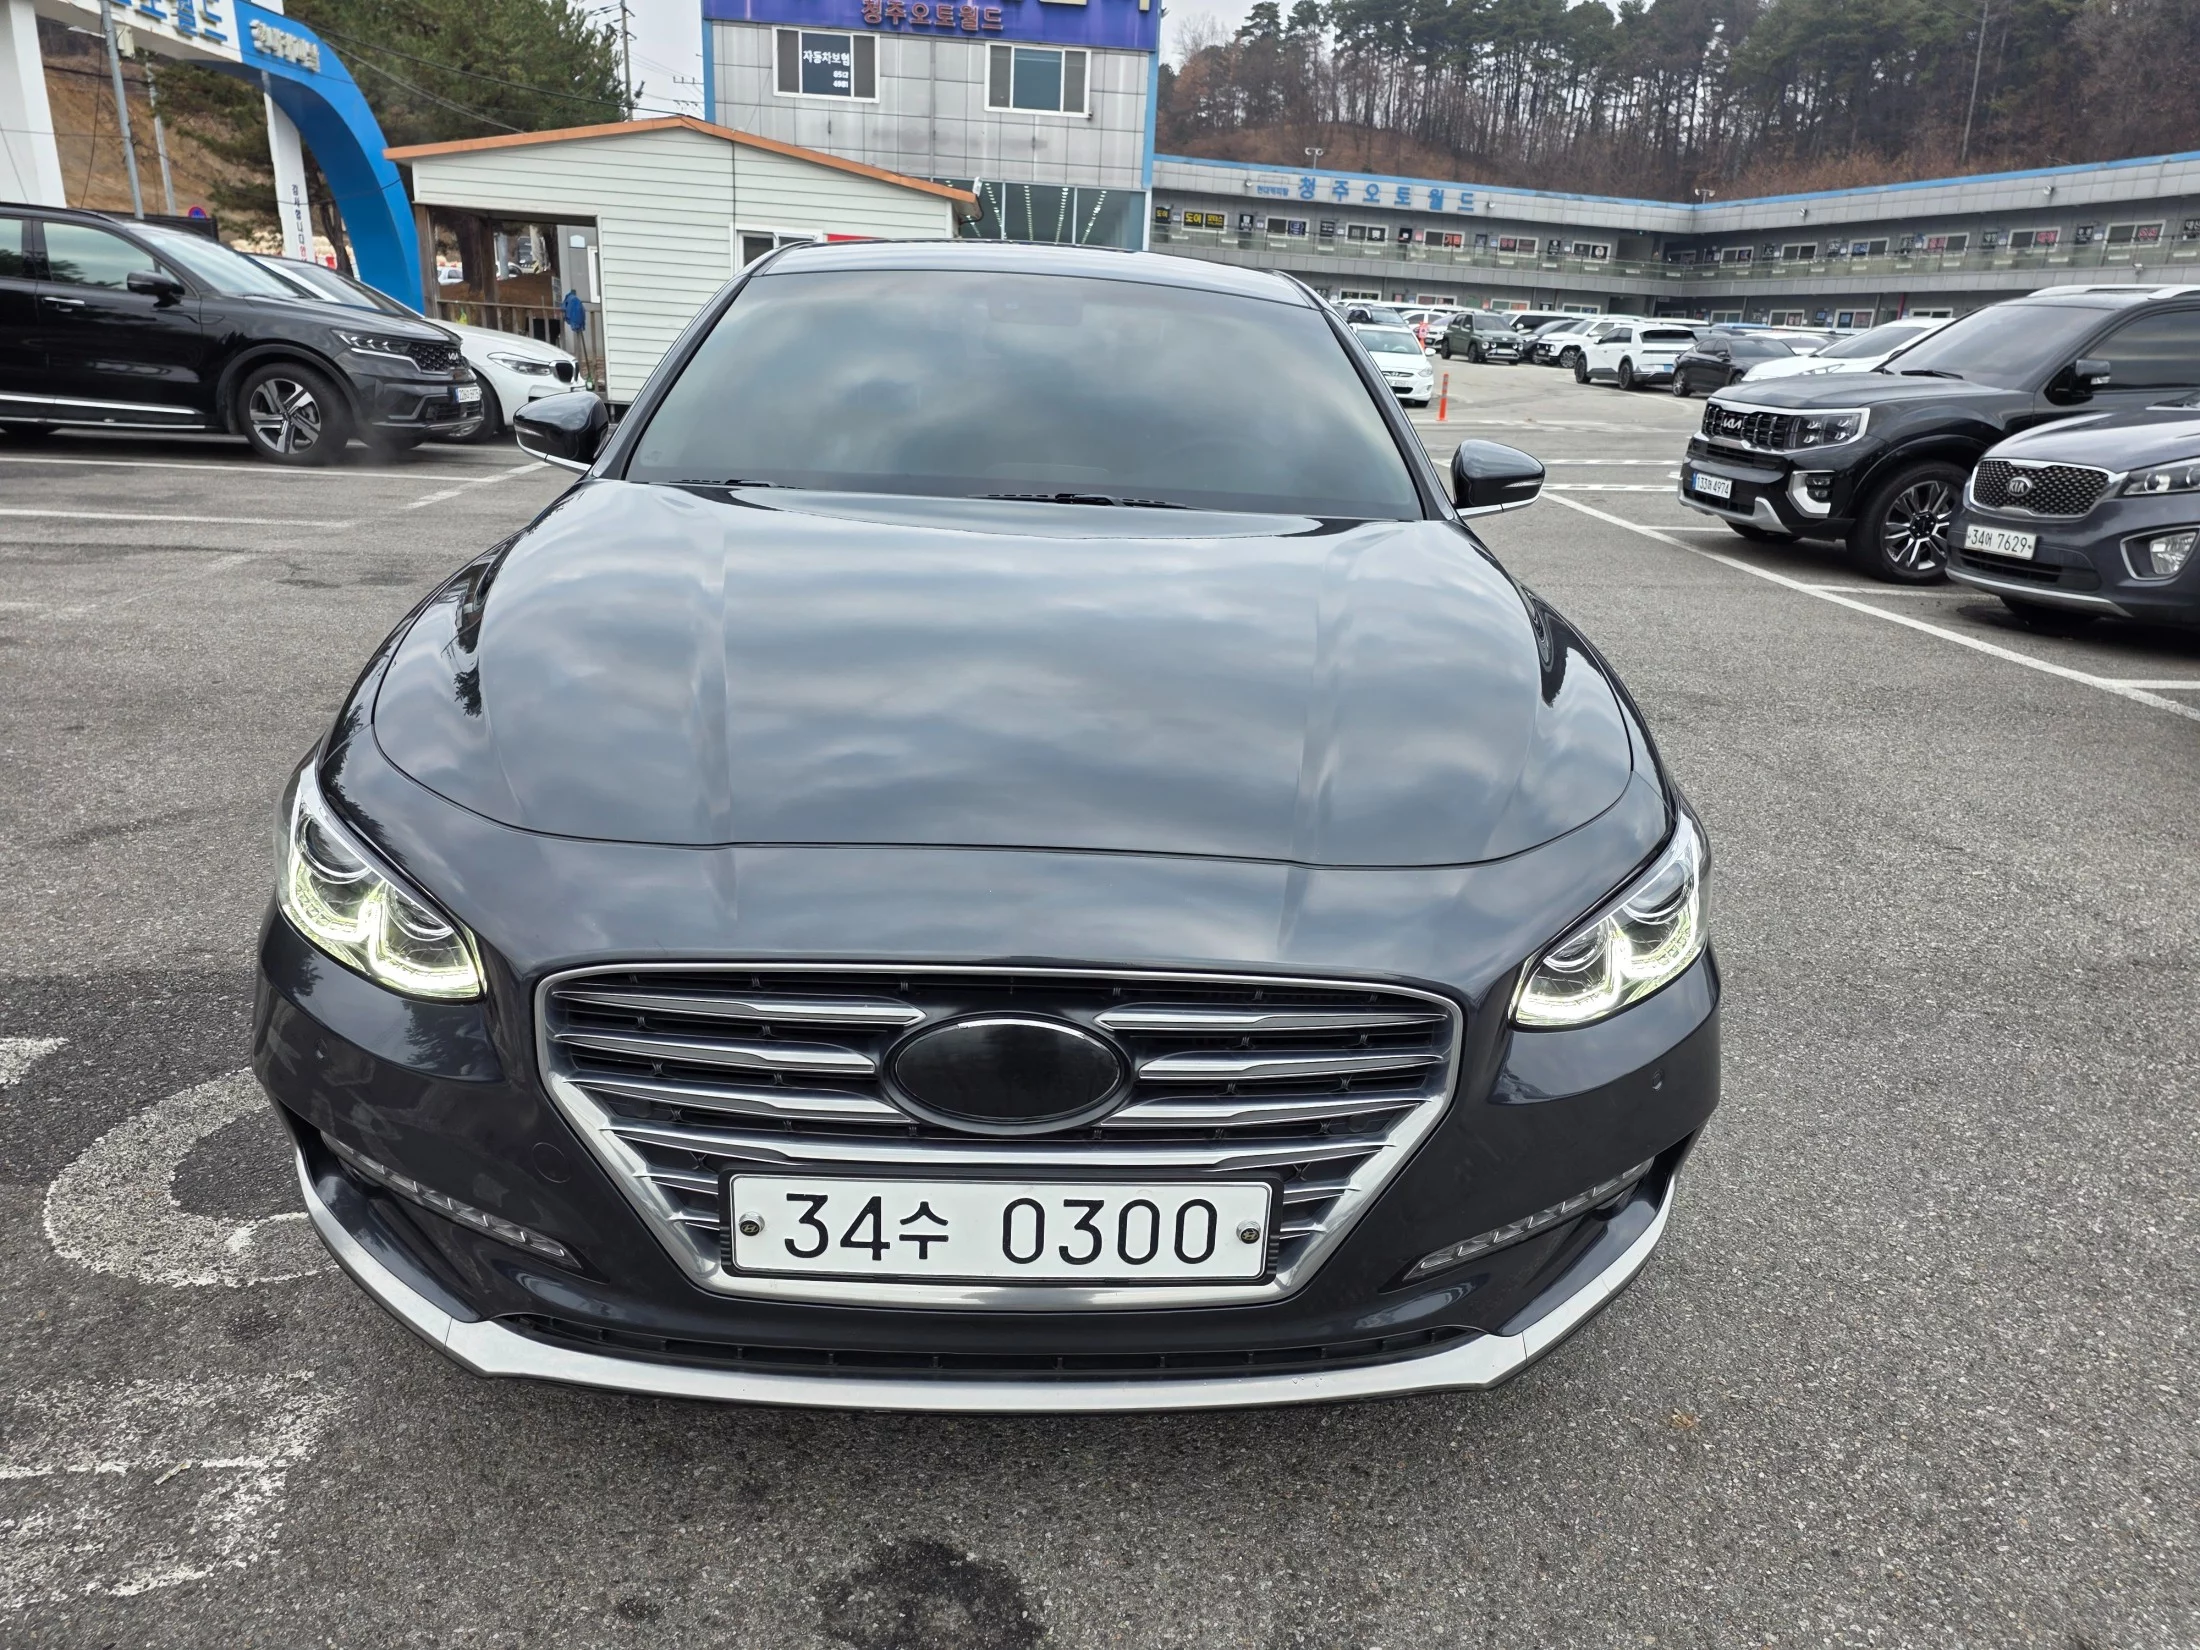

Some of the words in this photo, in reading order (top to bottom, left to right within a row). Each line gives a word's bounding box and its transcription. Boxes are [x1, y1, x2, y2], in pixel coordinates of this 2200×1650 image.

[111, 0, 229, 42] 월드
[861, 0, 1003, 31] 청주오토월드
[803, 49, 850, 67] 자동차보험
[1299, 176, 1475, 212] 청주오토월드
[291, 184, 305, 245] 감사합니다
[1723, 418, 1742, 430] KIA
[1712, 480, 1729, 494] 4974
[2008, 481, 2025, 493] KIA
[1971, 529, 1993, 547] 34어
[1997, 533, 2028, 553] 7629
[784, 1193, 949, 1261] 34수
[1001, 1198, 1218, 1266] 0300
